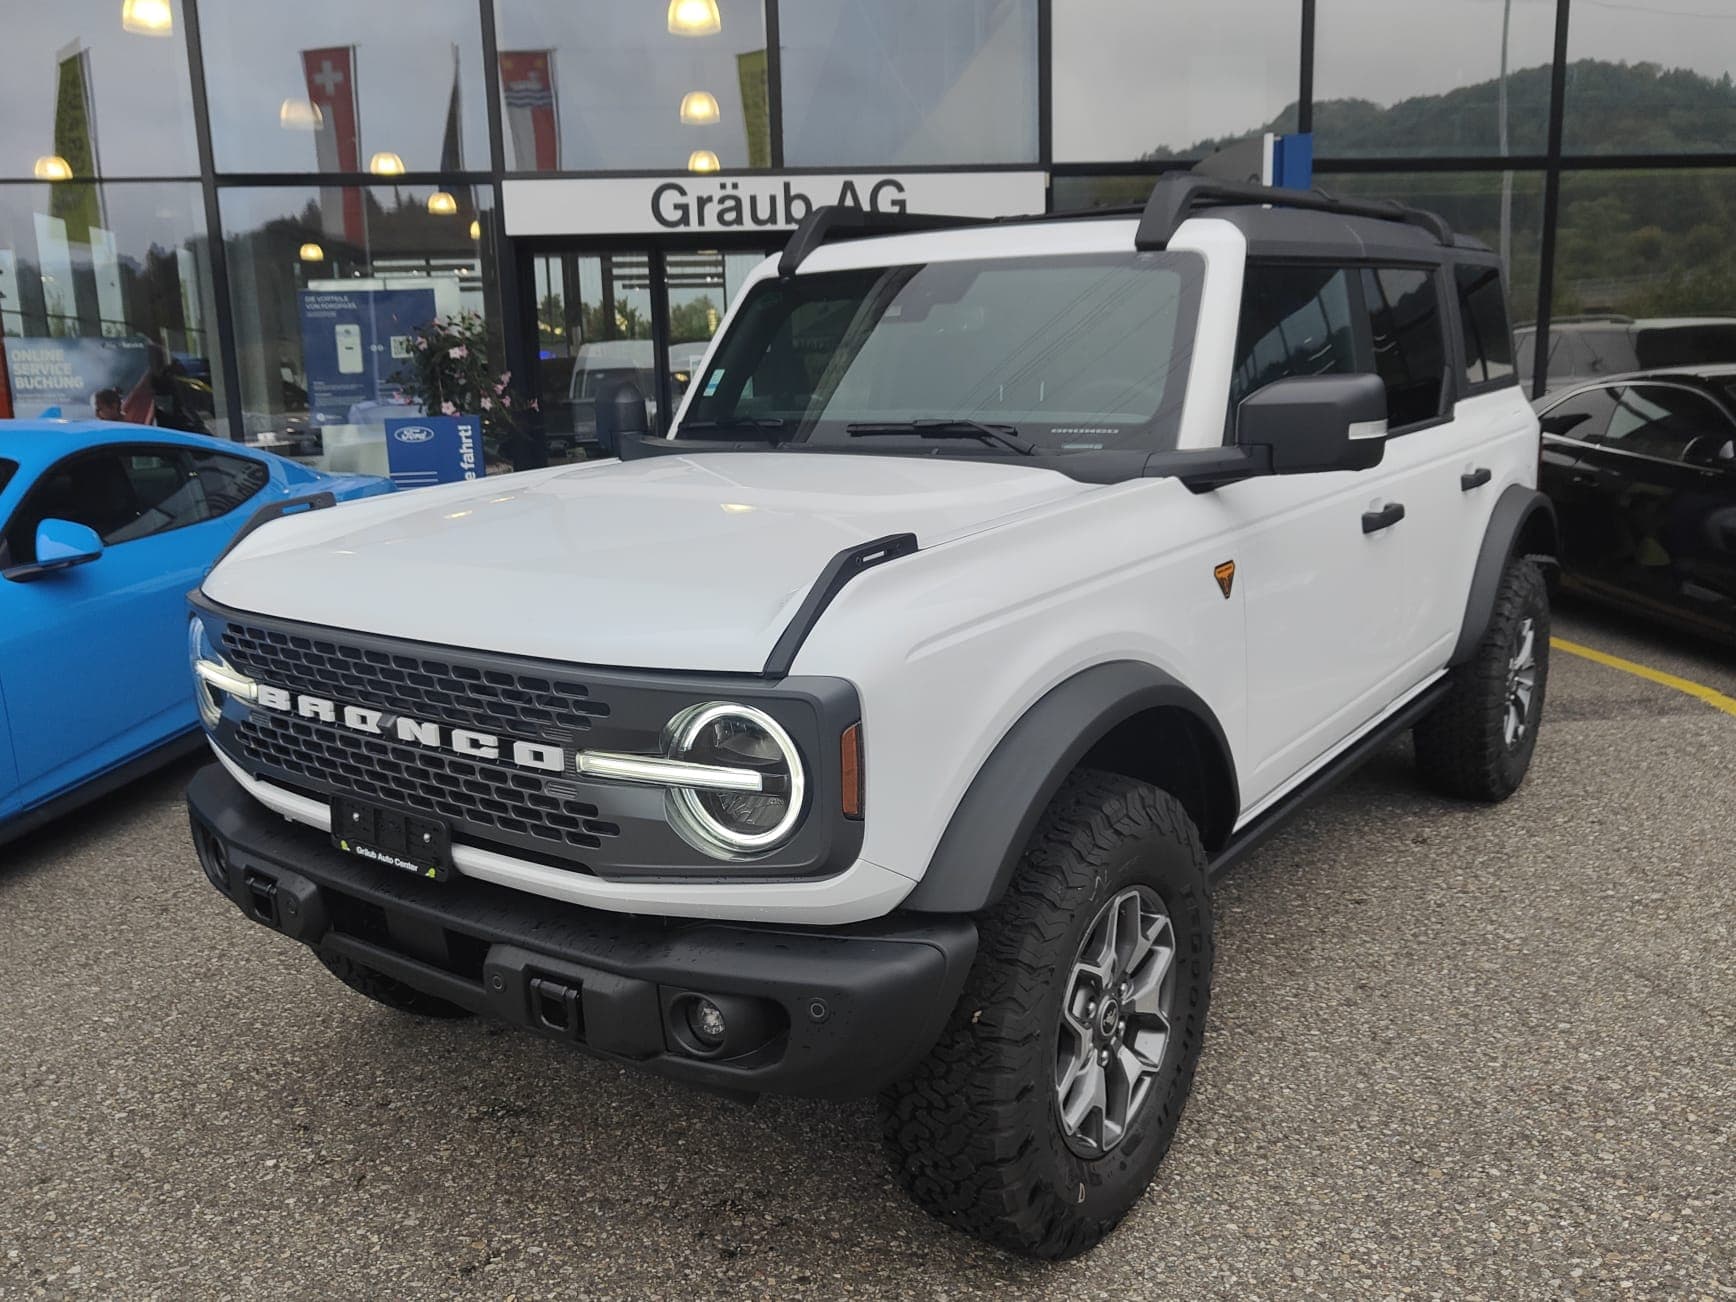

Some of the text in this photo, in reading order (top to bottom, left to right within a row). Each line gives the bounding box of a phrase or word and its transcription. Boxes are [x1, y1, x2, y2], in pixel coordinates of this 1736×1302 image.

[651, 178, 906, 229] Gräub AG
[12, 350, 64, 361] ONLINE
[14, 363, 72, 375] SERVICE
[15, 376, 84, 389] BUCHUNG
[257, 684, 565, 772] BRONCO
[377, 852, 394, 864] Auto
[394, 858, 419, 871] Center
